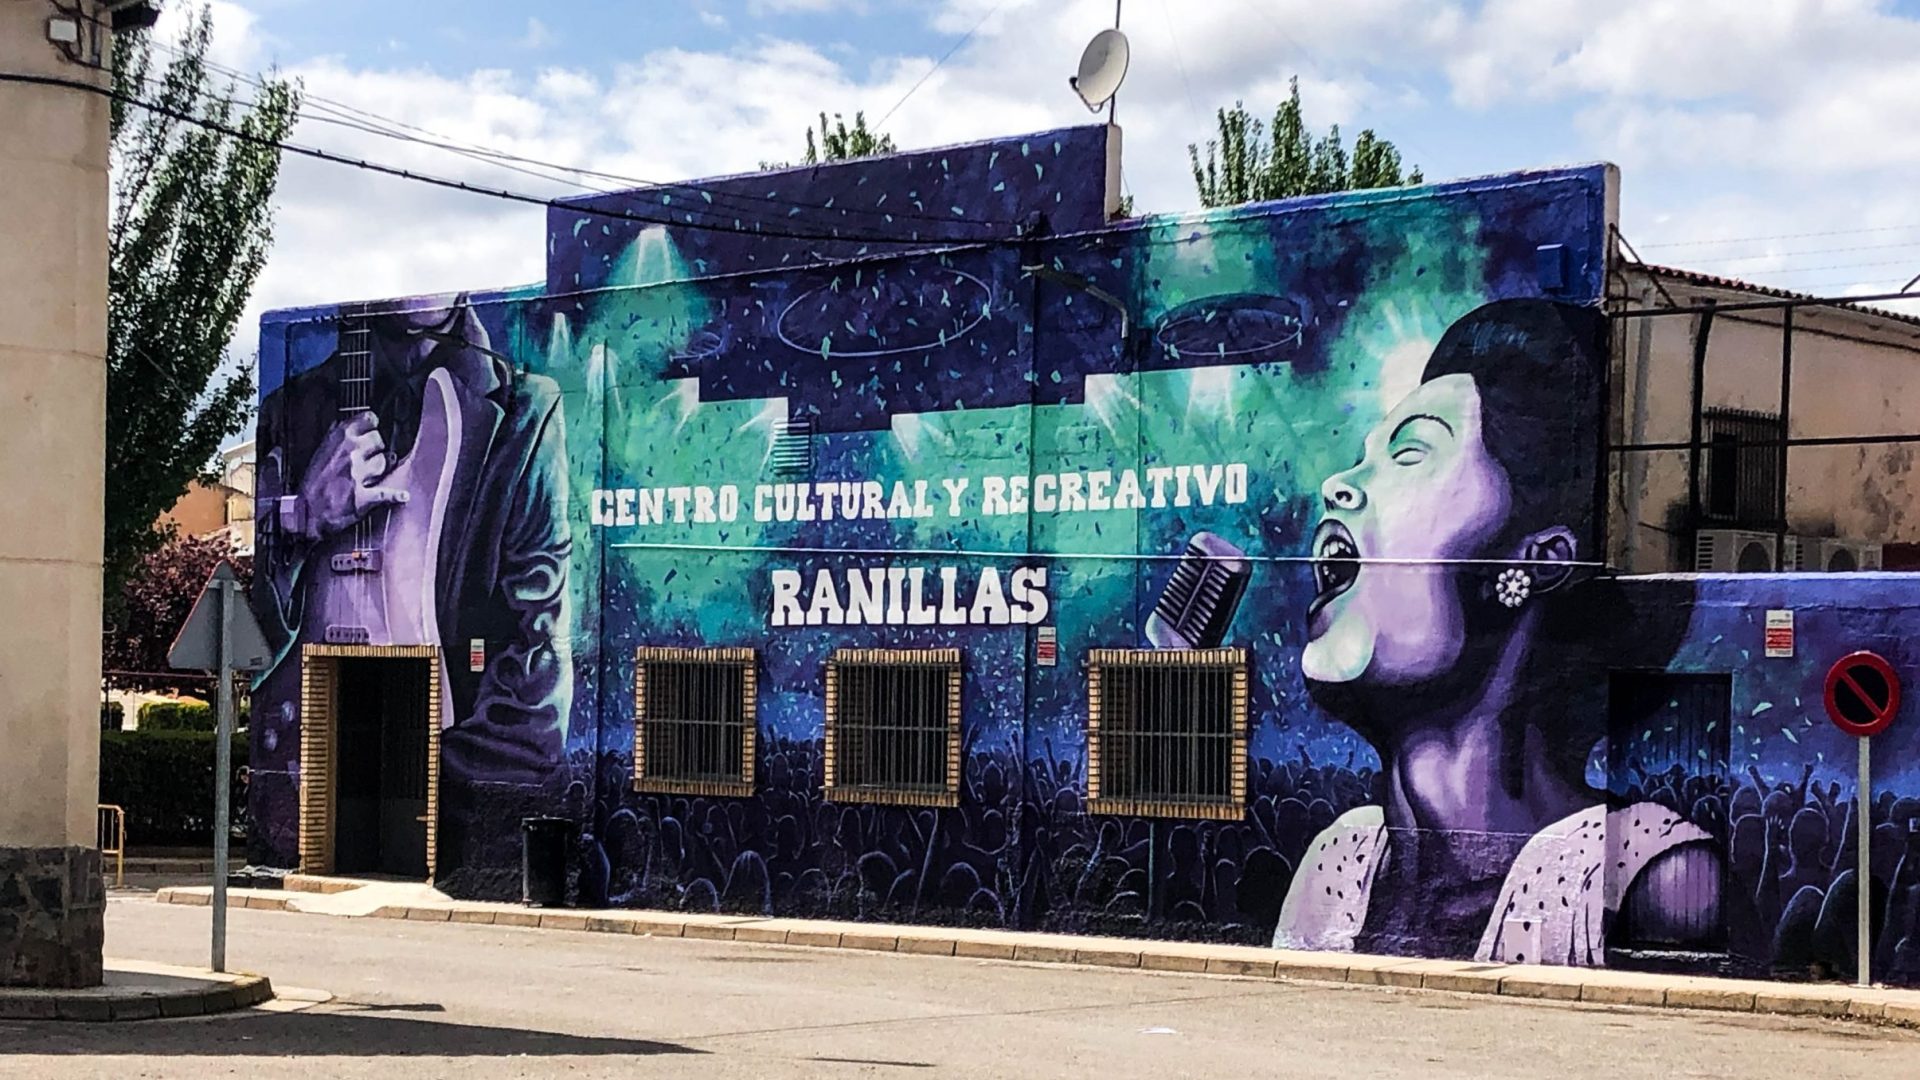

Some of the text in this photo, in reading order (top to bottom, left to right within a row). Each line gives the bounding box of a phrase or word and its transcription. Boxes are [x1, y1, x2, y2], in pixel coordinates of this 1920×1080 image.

[591, 463, 1248, 527] CENTRO CULTURAL Y RECREATIVO
[770, 566, 1049, 626] RANILLAS
